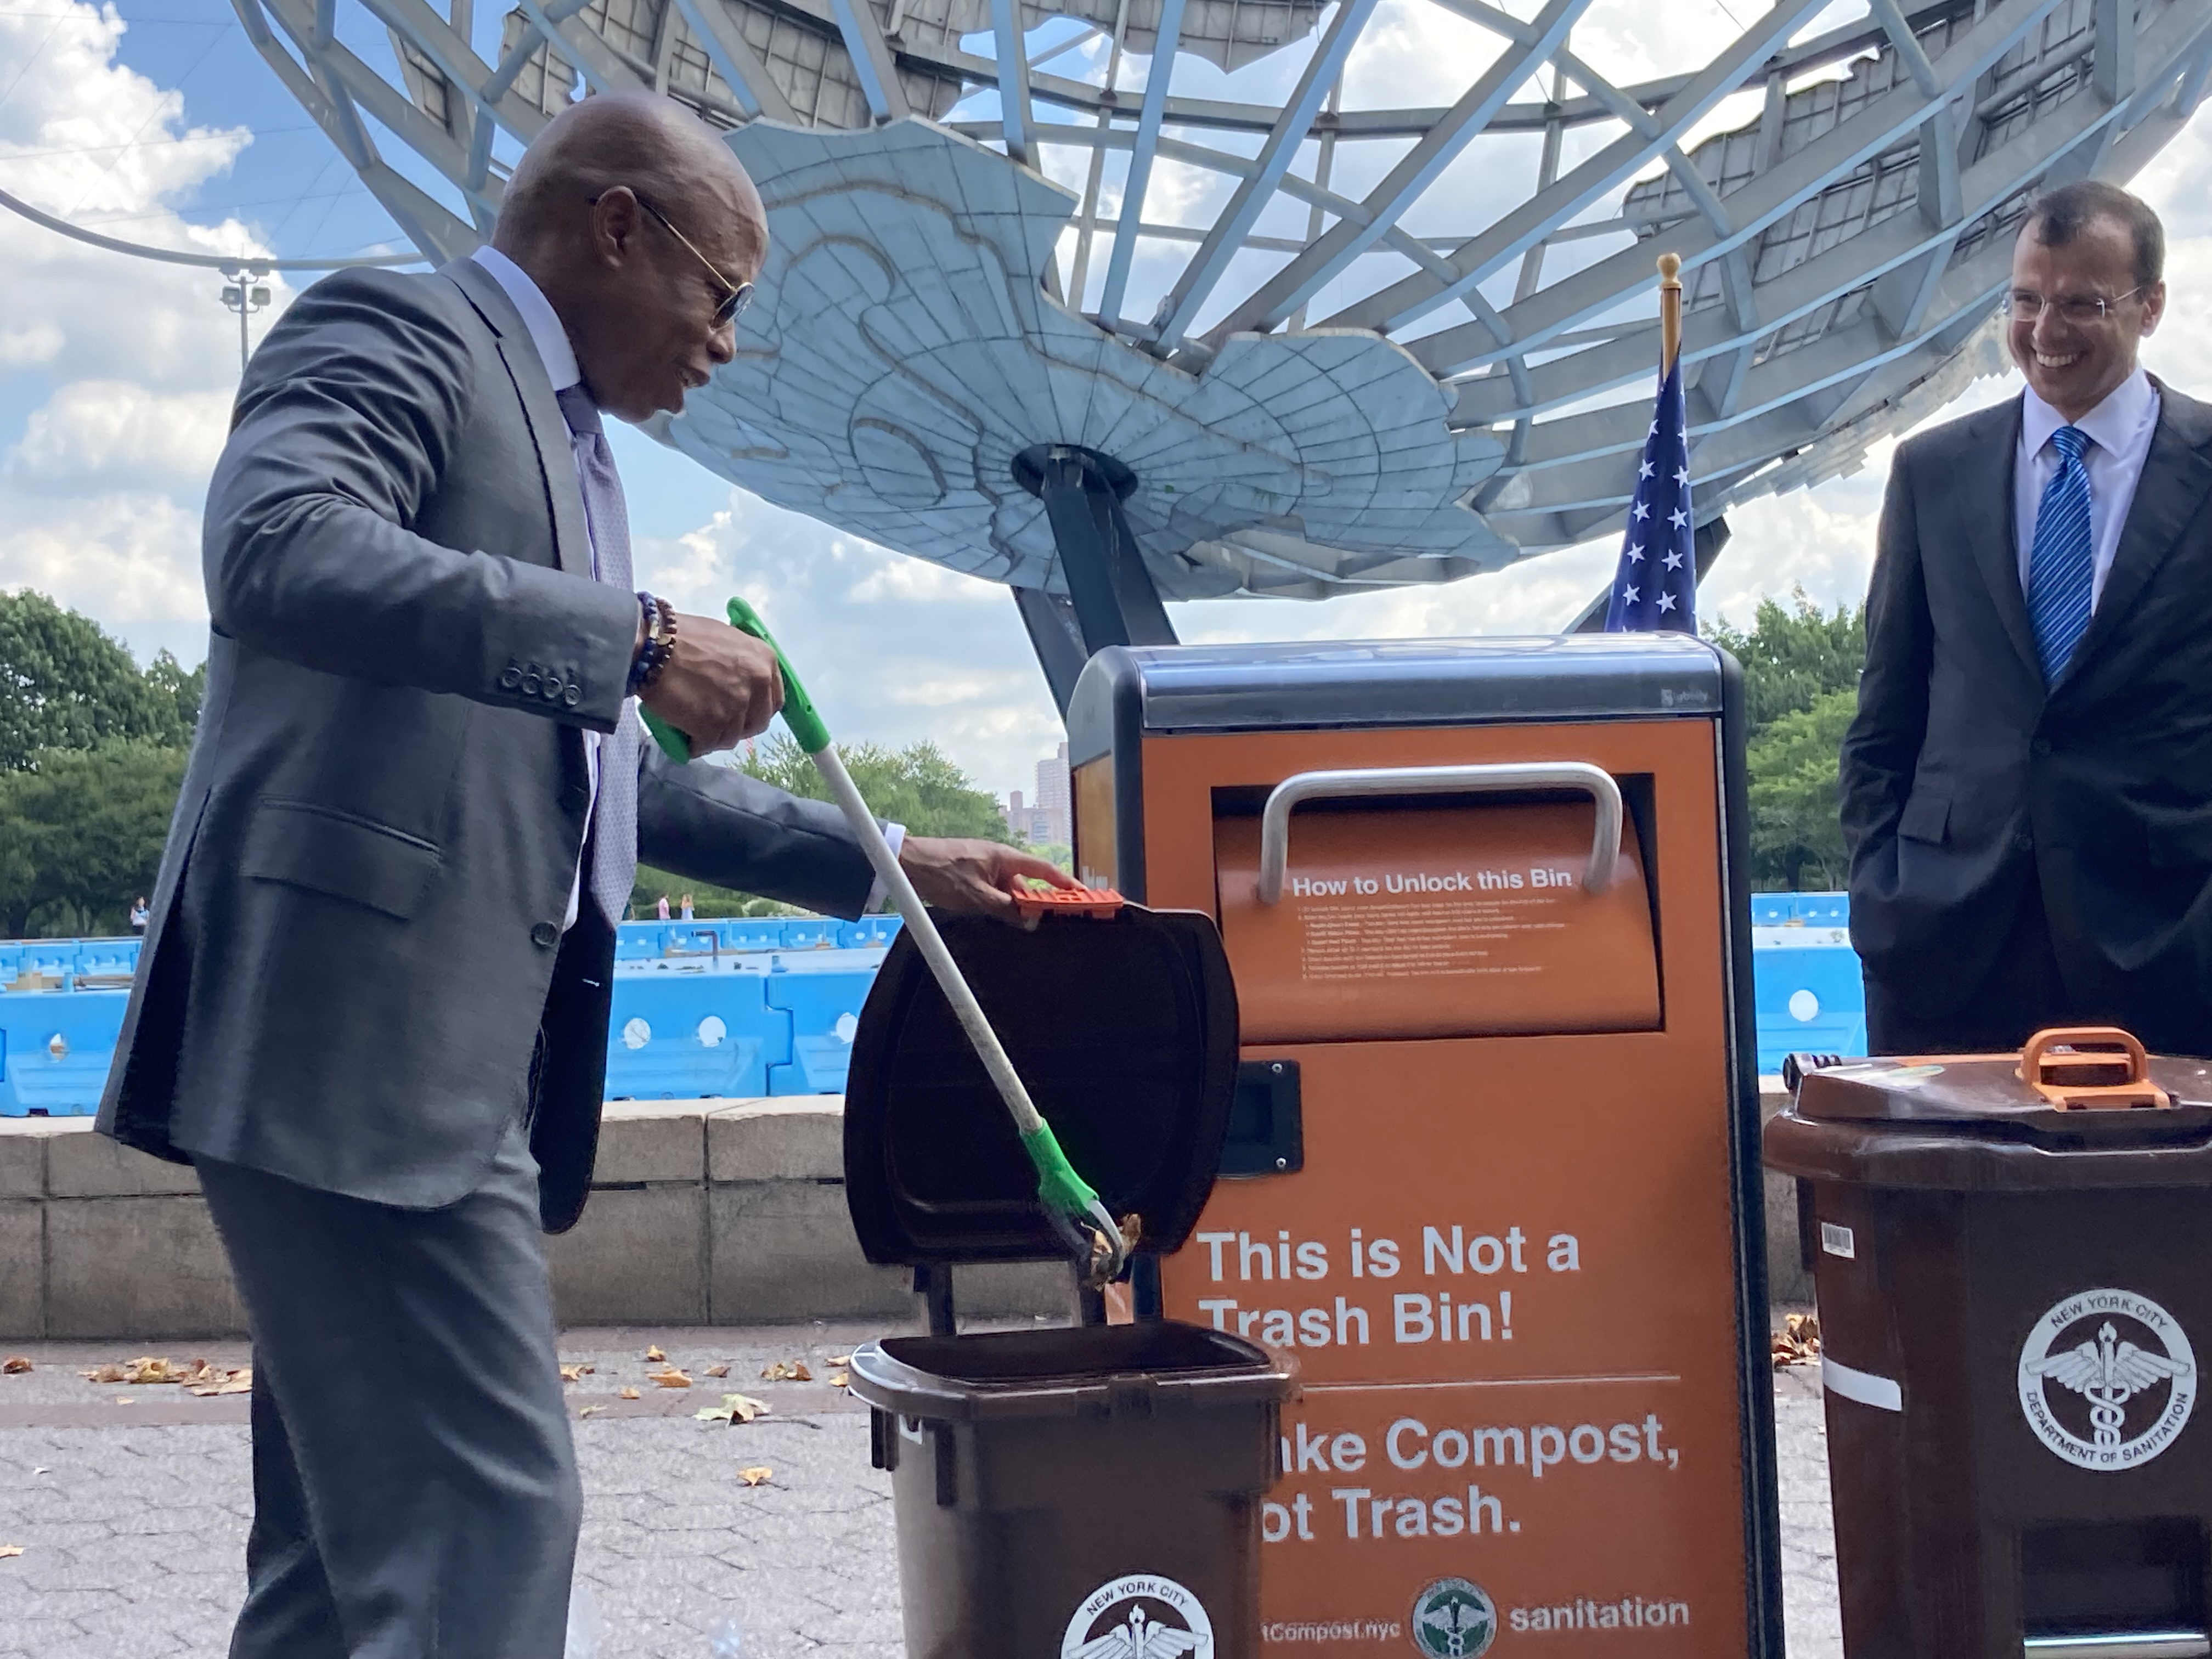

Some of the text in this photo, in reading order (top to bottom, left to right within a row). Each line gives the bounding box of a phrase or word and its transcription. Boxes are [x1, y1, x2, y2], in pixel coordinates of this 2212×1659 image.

[1293, 868, 1572, 897] How to Unlock this Bin
[1197, 1224, 1580, 1282] This is Not a
[1198, 1291, 1513, 1347] Trash Bin!
[2051, 1296, 2168, 1329] NEW YORK CITY
[1386, 1414, 1679, 1479] Compost,
[2027, 1391, 2188, 1464] DEPARTMENT OF SANITATION
[1331, 1485, 1521, 1538] Trash.
[1087, 1581, 1189, 1616] NEW YORK CITY
[1509, 1596, 1689, 1632] sanitation
